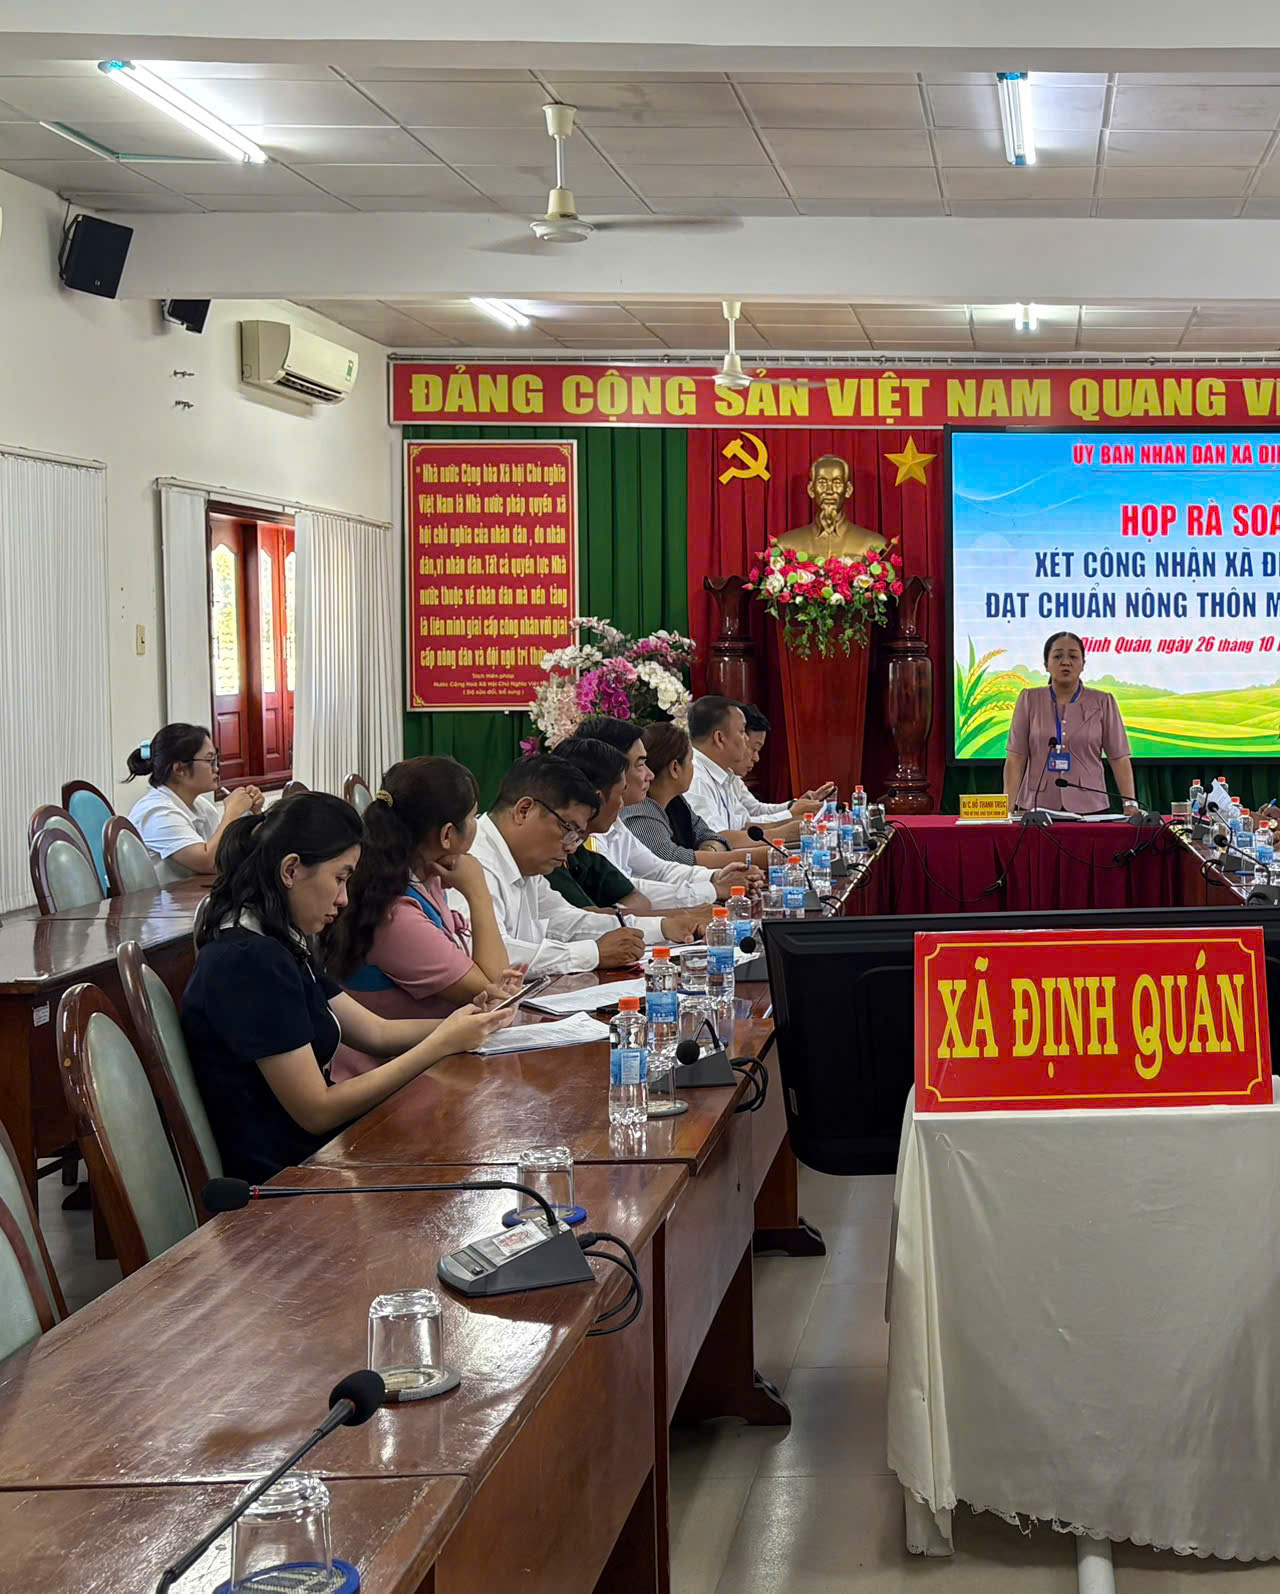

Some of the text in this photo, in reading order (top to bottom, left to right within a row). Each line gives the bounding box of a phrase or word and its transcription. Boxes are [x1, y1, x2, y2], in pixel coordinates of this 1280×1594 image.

[409, 364, 544, 414] ĐẢNG
[562, 371, 697, 422] CỘNG
[714, 367, 810, 417] SẢN
[826, 371, 930, 424] VIỆT
[947, 378, 1051, 417] NAM
[1069, 378, 1226, 421] QUANG
[1073, 441, 1094, 465] ỦY
[1101, 445, 1135, 464] BAN
[1140, 442, 1186, 464] NHÂN
[1192, 442, 1226, 464] DÂN
[1231, 442, 1253, 464] XÃ
[1121, 504, 1177, 543] HỌP
[1187, 498, 1223, 537] RÀ
[1035, 547, 1075, 578] XÉT
[1083, 546, 1146, 578] CÔNG
[1155, 546, 1216, 583] NHẬN
[1225, 547, 1254, 577] XÃ
[985, 592, 1029, 623] ĐẠT
[1038, 582, 1116, 618] CHUẨN
[1126, 587, 1188, 618] NÔNG
[1196, 587, 1256, 618] THÔN
[1114, 636, 1152, 654] Quán,
[1157, 636, 1194, 655] ngày
[1197, 636, 1216, 652] 26
[1218, 638, 1254, 653] tháng
[1259, 636, 1275, 652] 10
[937, 949, 1245, 1080] XÃ ĐỊNH QUÁN
